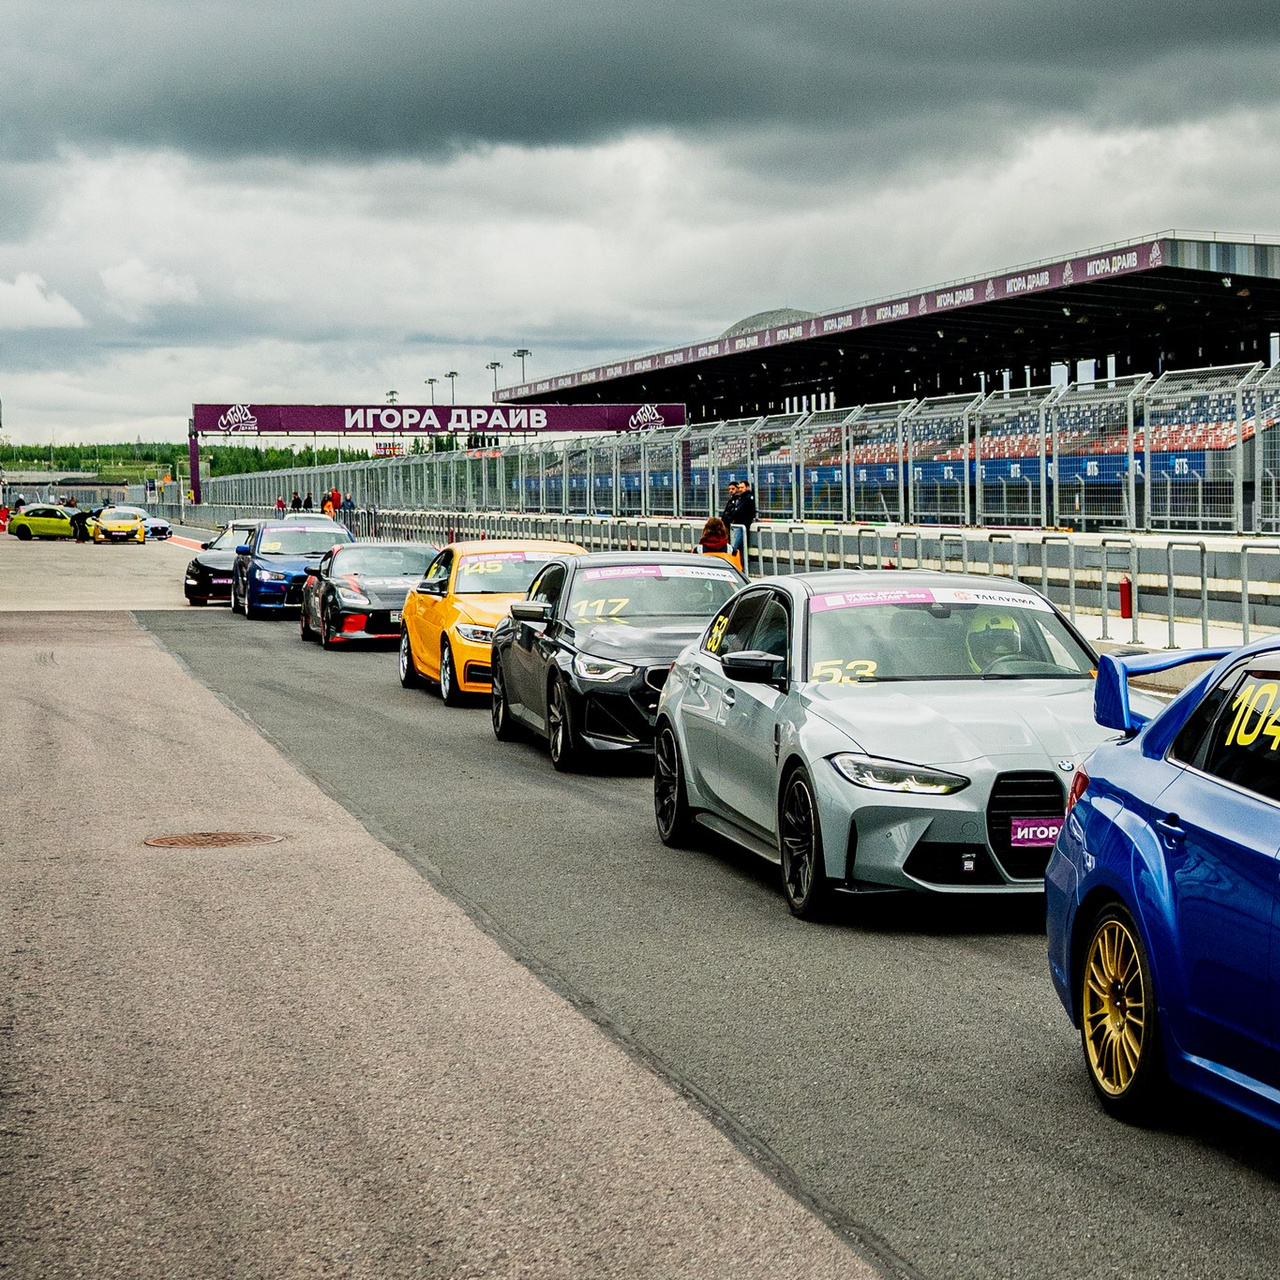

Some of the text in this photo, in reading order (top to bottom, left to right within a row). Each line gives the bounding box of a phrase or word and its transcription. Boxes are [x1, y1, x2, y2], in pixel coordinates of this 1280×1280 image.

[344, 408, 548, 432] ИГОРА ДРАЙВ
[1086, 461, 1099, 476] ВТБ
[1175, 458, 1188, 474] ВТБ
[458, 560, 503, 576] 145
[572, 598, 629, 617] 117
[974, 593, 1036, 606] TAKAYAMA
[706, 615, 729, 652] 53
[811, 659, 878, 684] 53
[1017, 826, 1062, 839] ИГОР
